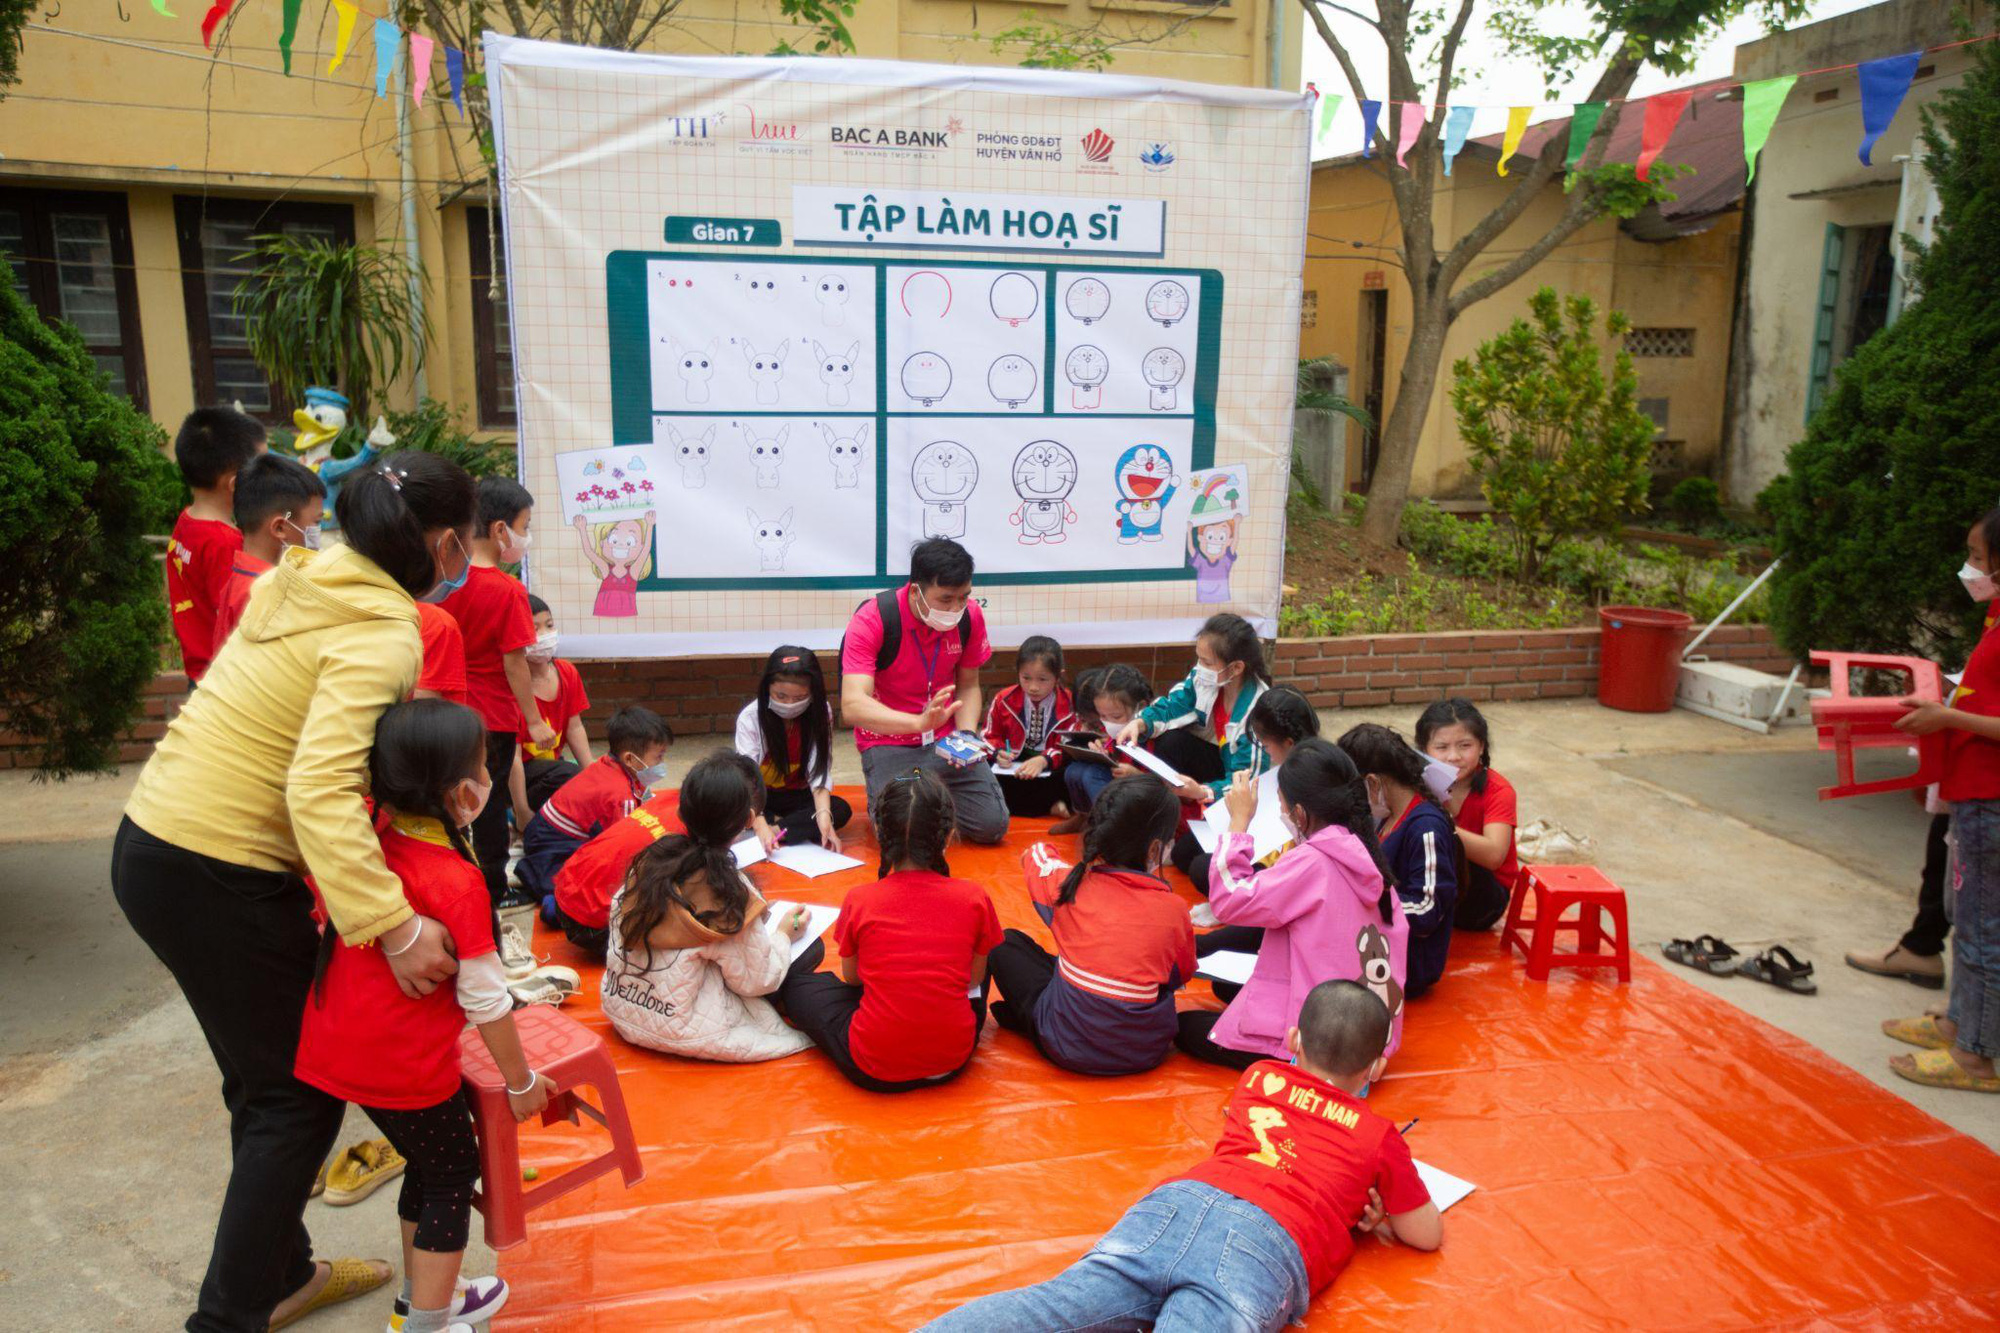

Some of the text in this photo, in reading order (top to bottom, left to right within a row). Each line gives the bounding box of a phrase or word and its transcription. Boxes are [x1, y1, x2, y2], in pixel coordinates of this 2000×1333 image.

[667, 117, 707, 138] TH
[831, 127, 948, 148] BAC A BANK
[1021, 136, 1062, 147] GD&ĐT
[692, 222, 755, 242] Gian 7
[834, 194, 1122, 249] TẬP LÀM HOẠ SĨ
[1246, 1070, 1261, 1089] I
[1322, 1100, 1360, 1130] NAM
